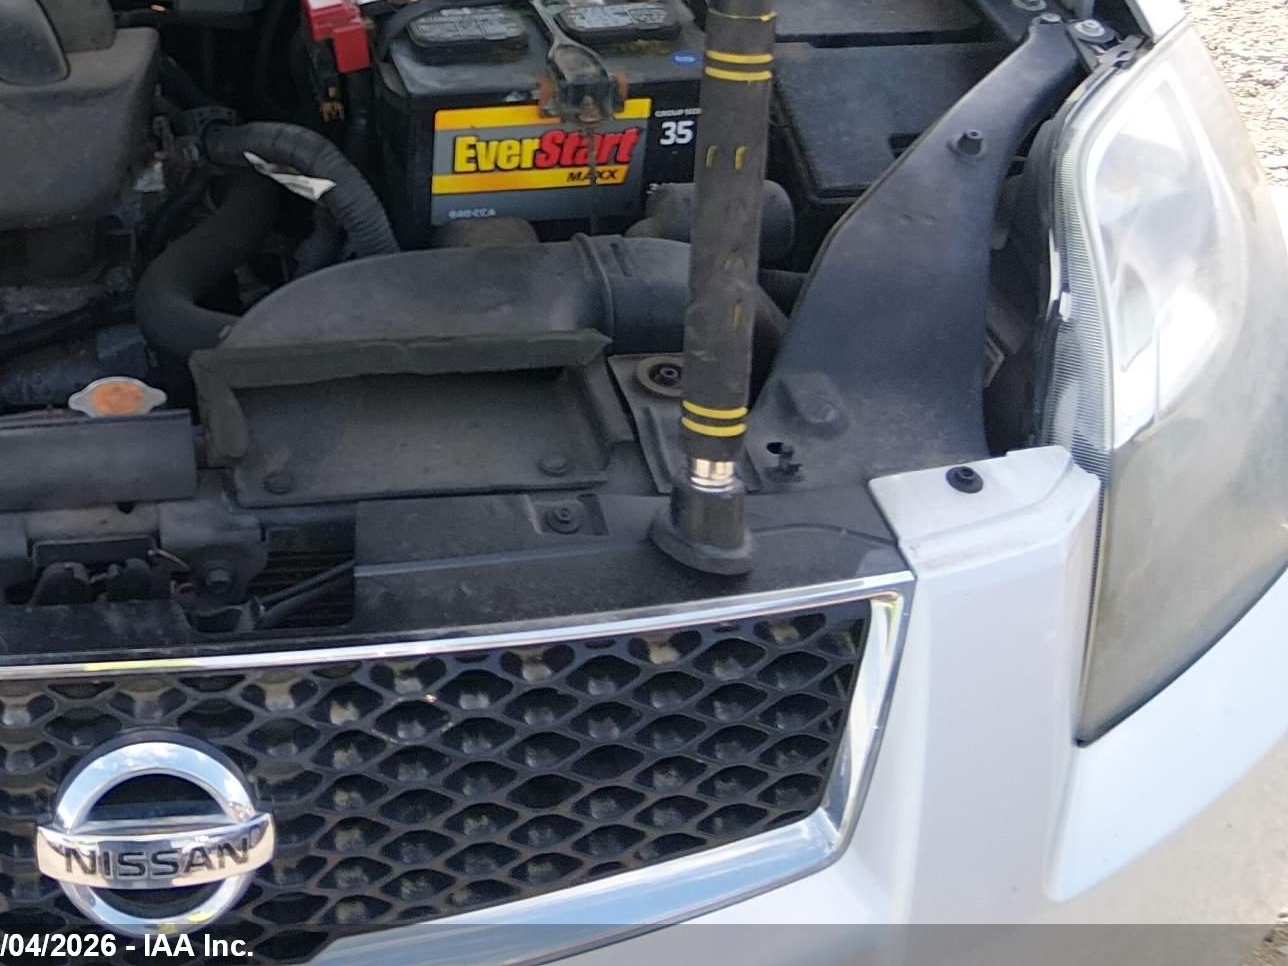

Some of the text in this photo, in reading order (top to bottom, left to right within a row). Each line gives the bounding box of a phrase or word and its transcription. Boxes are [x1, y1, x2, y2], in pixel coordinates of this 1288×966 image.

[453, 126, 640, 175] EverStart
[659, 120, 695, 146] 35
[64, 836, 250, 878] NISSAN
